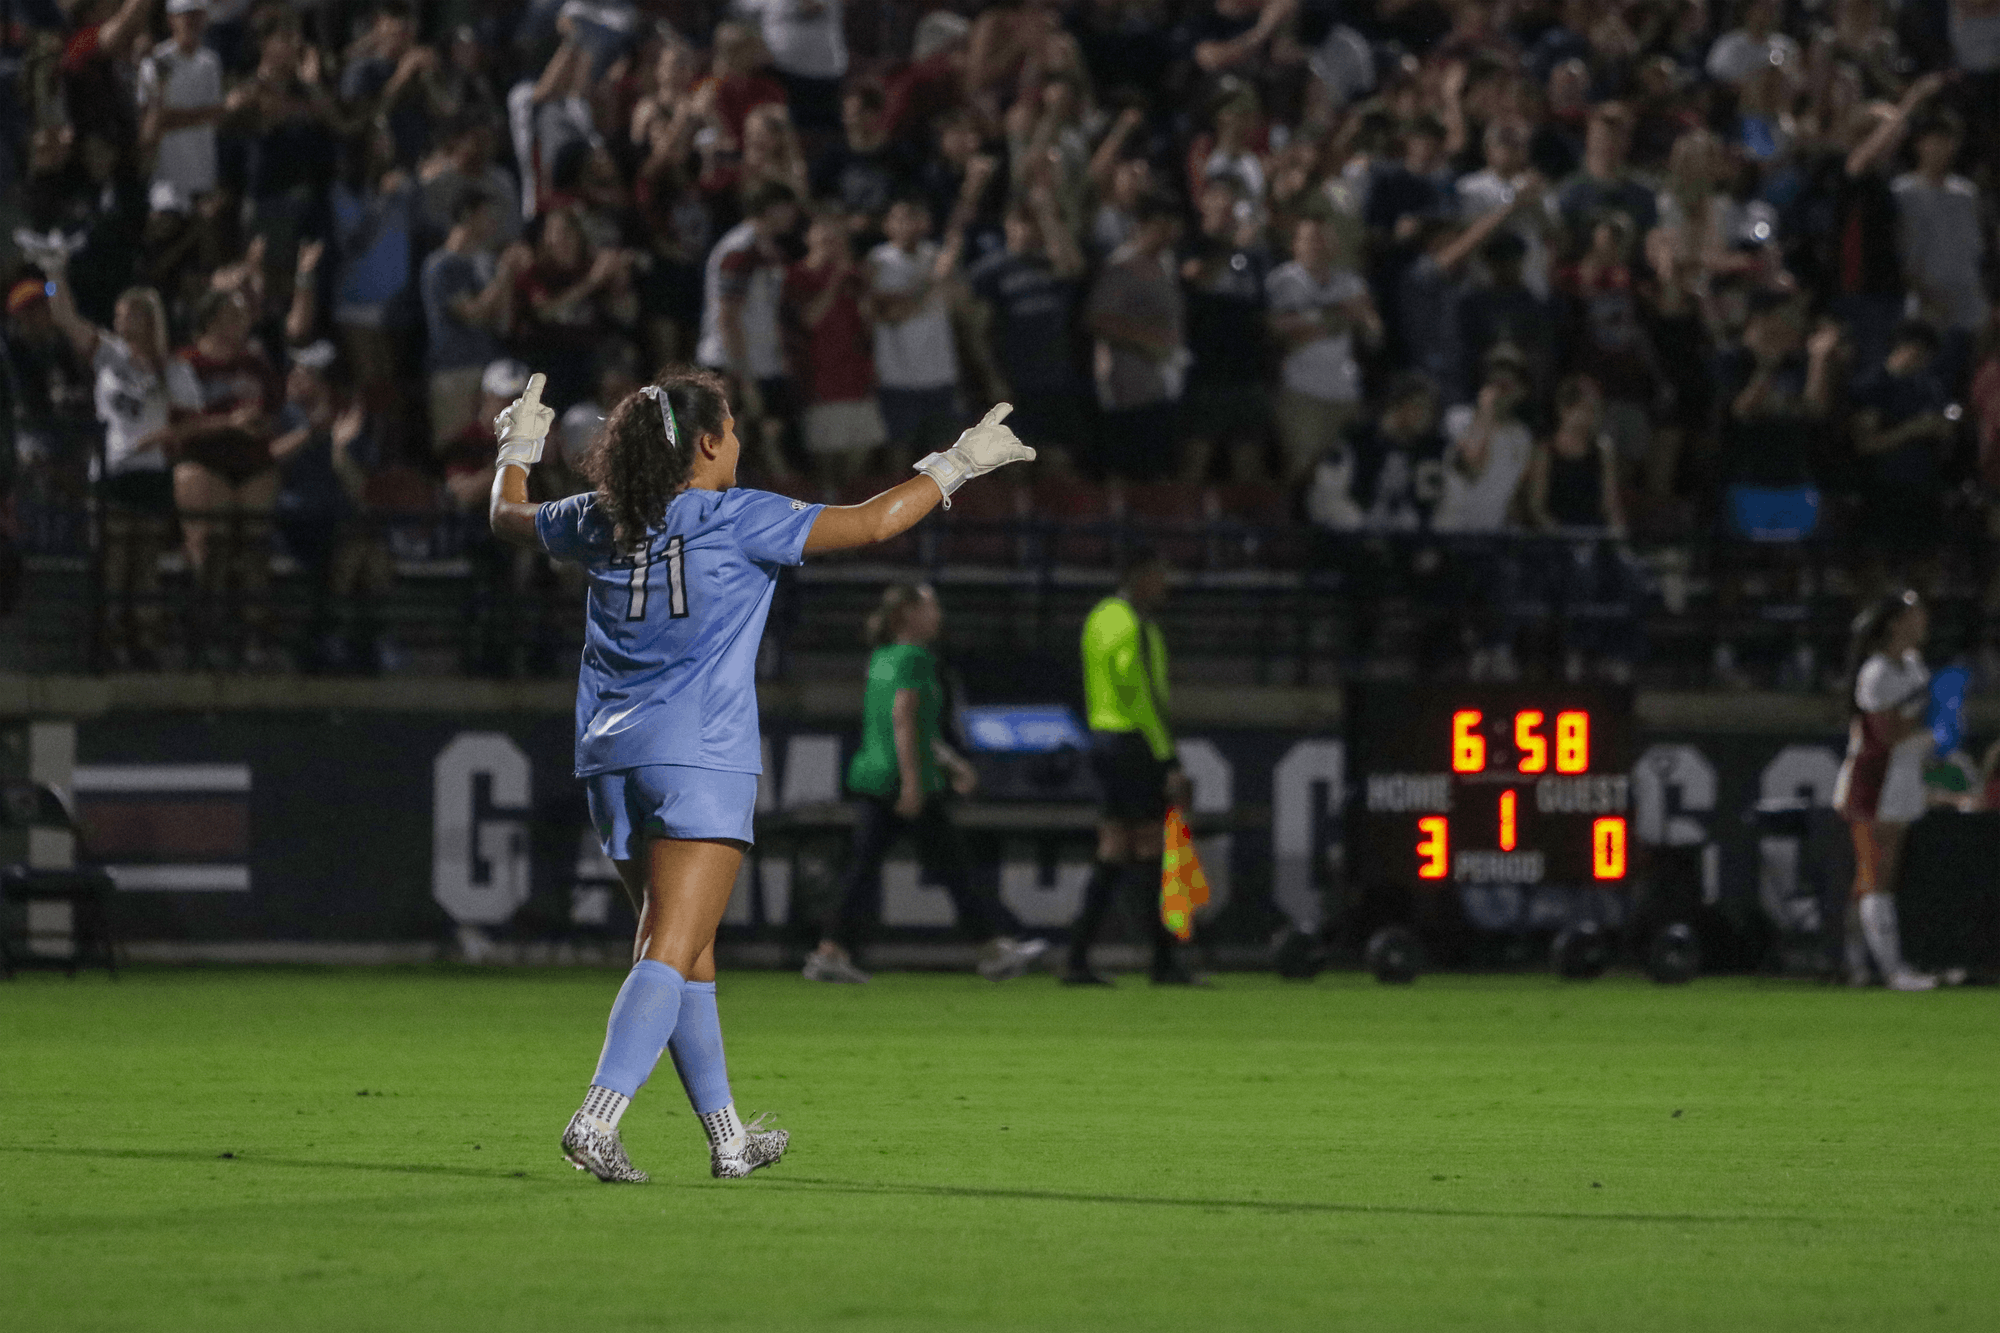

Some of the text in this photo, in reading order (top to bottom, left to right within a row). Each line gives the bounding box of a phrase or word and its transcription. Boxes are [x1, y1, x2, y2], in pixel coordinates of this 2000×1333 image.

[1366, 773, 1450, 813] HOME
[1499, 789, 1517, 851] 1
[1537, 774, 1628, 813] GUEST
[1415, 816, 1449, 880] 3
[1593, 816, 1627, 880] 0
